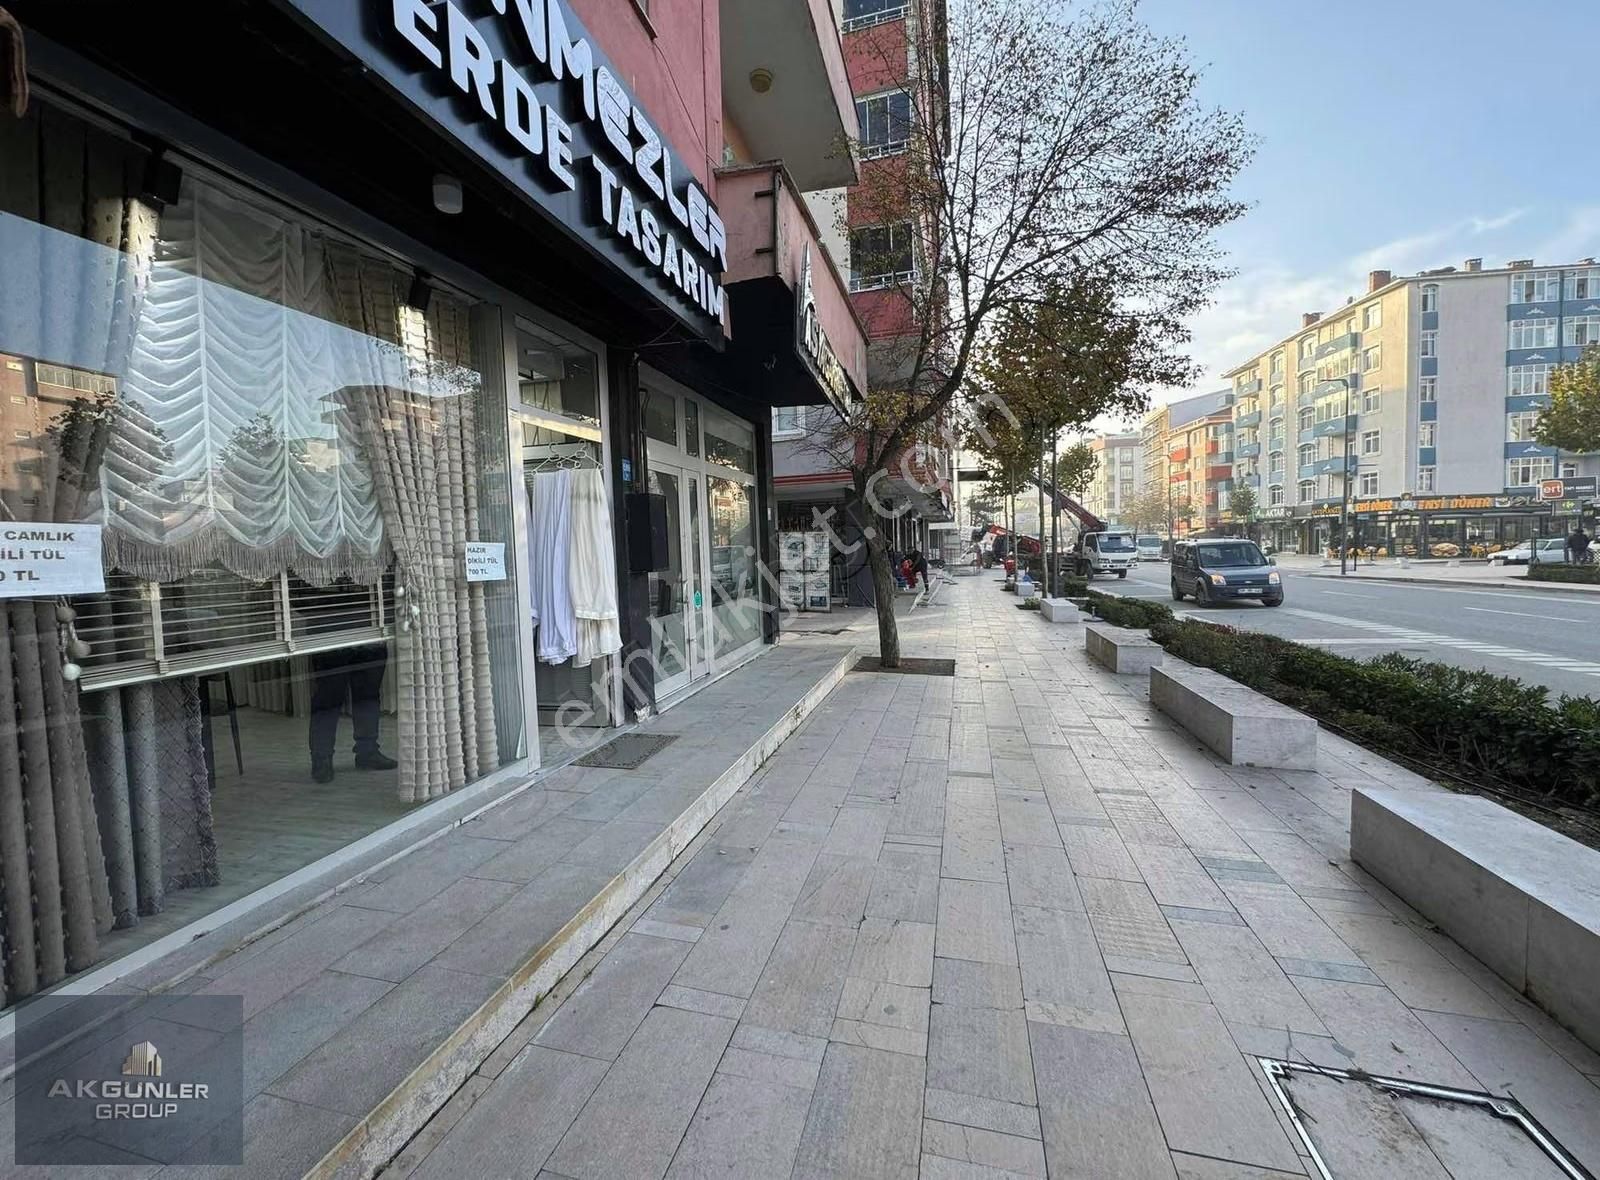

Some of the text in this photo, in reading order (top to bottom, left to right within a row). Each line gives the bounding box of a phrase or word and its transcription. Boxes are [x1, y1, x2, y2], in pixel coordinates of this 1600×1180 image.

[393, 0, 725, 326] ERDE TASARIM
[1265, 508, 1285, 517] AKTAR
[4, 530, 75, 542] CAMLIK
[30, 548, 65, 560] TÜL
[487, 556, 498, 564] TÜL
[13, 570, 40, 581] TL
